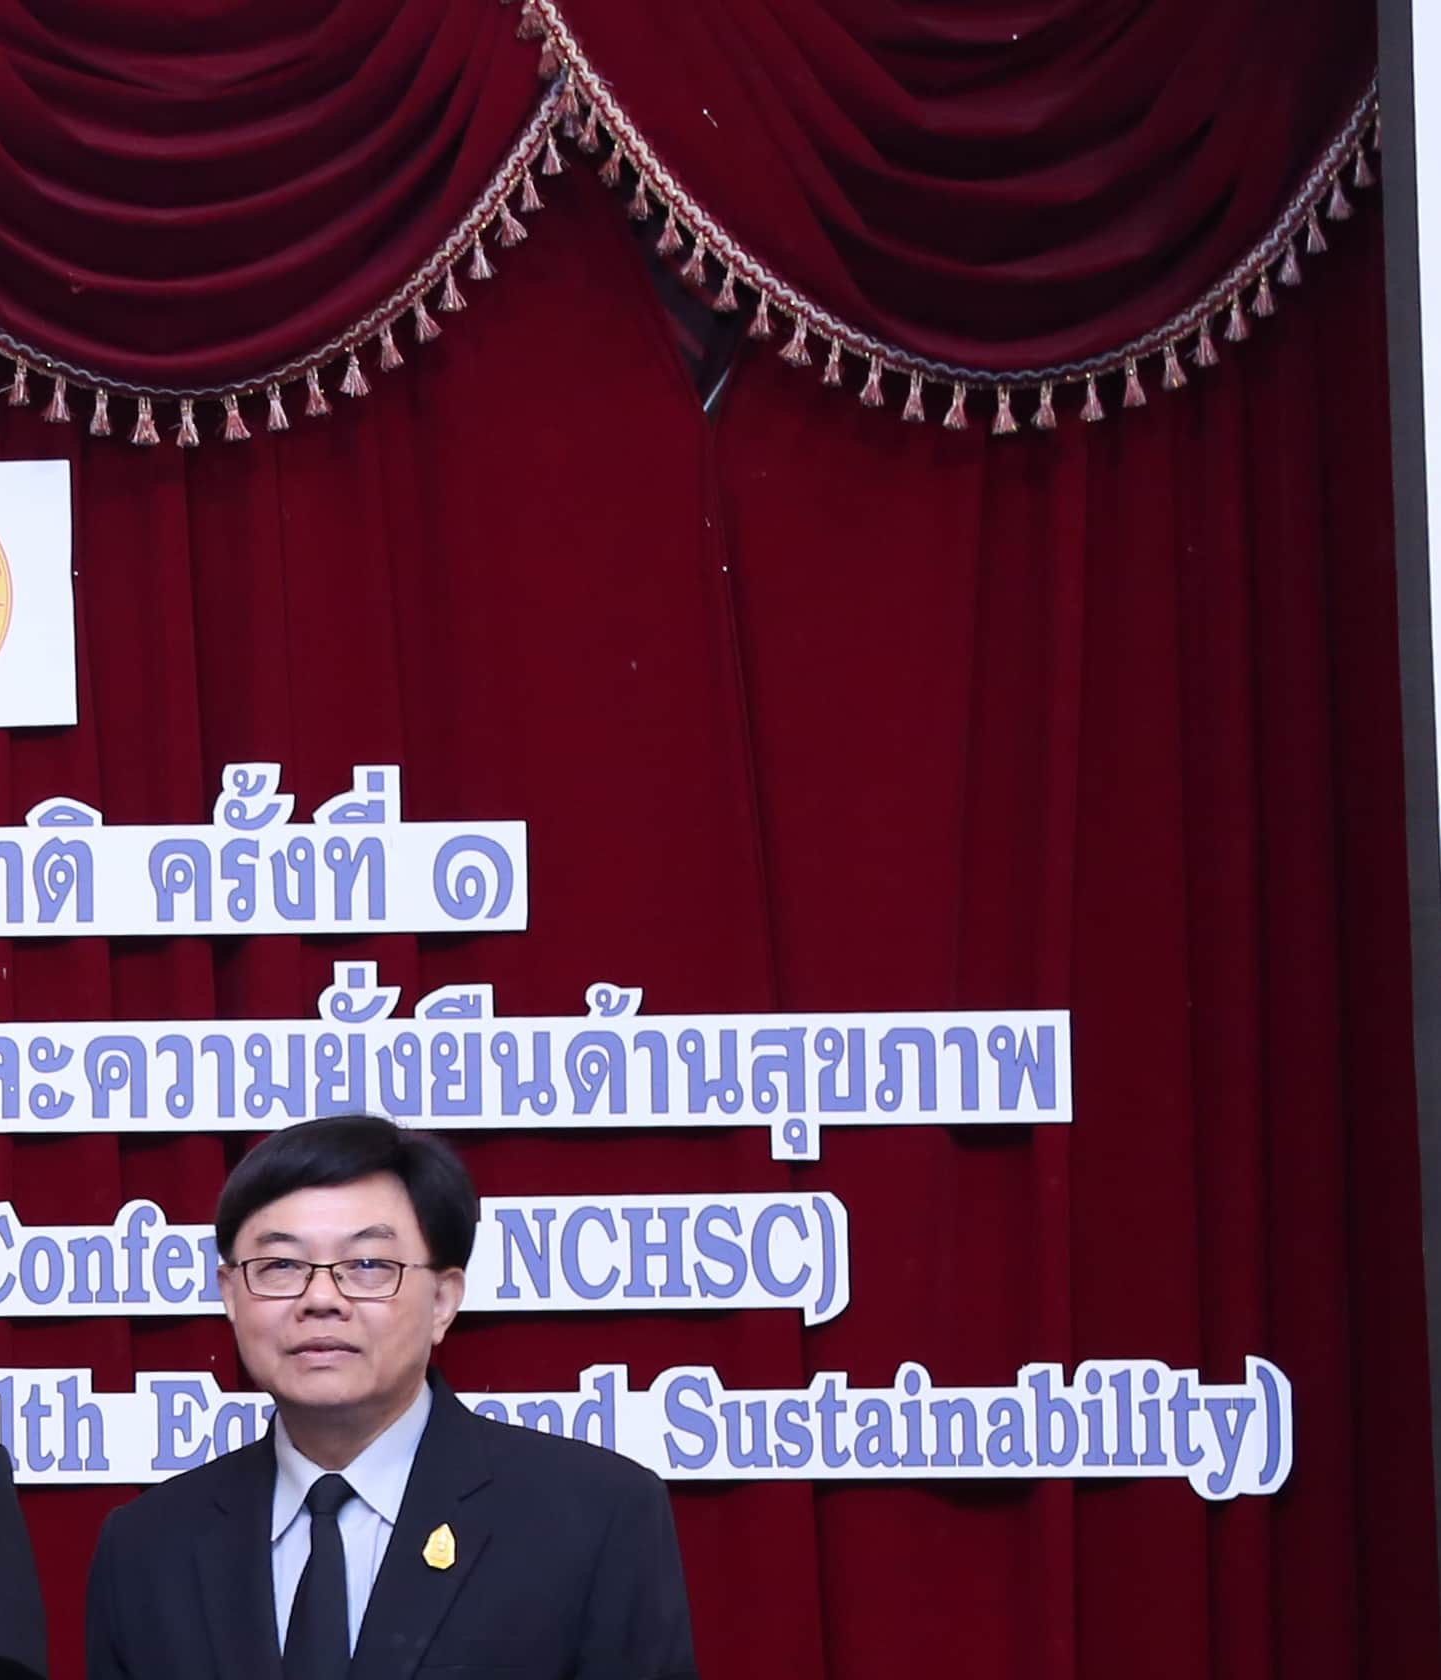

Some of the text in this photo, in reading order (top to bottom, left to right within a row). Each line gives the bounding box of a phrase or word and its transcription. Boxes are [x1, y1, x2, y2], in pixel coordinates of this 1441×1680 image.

[147, 768, 387, 925] ครั้งที่
[432, 833, 515, 922] ๑
[494, 1196, 837, 1315] NCHSC)
[663, 1365, 1281, 1494] Sustainability)
